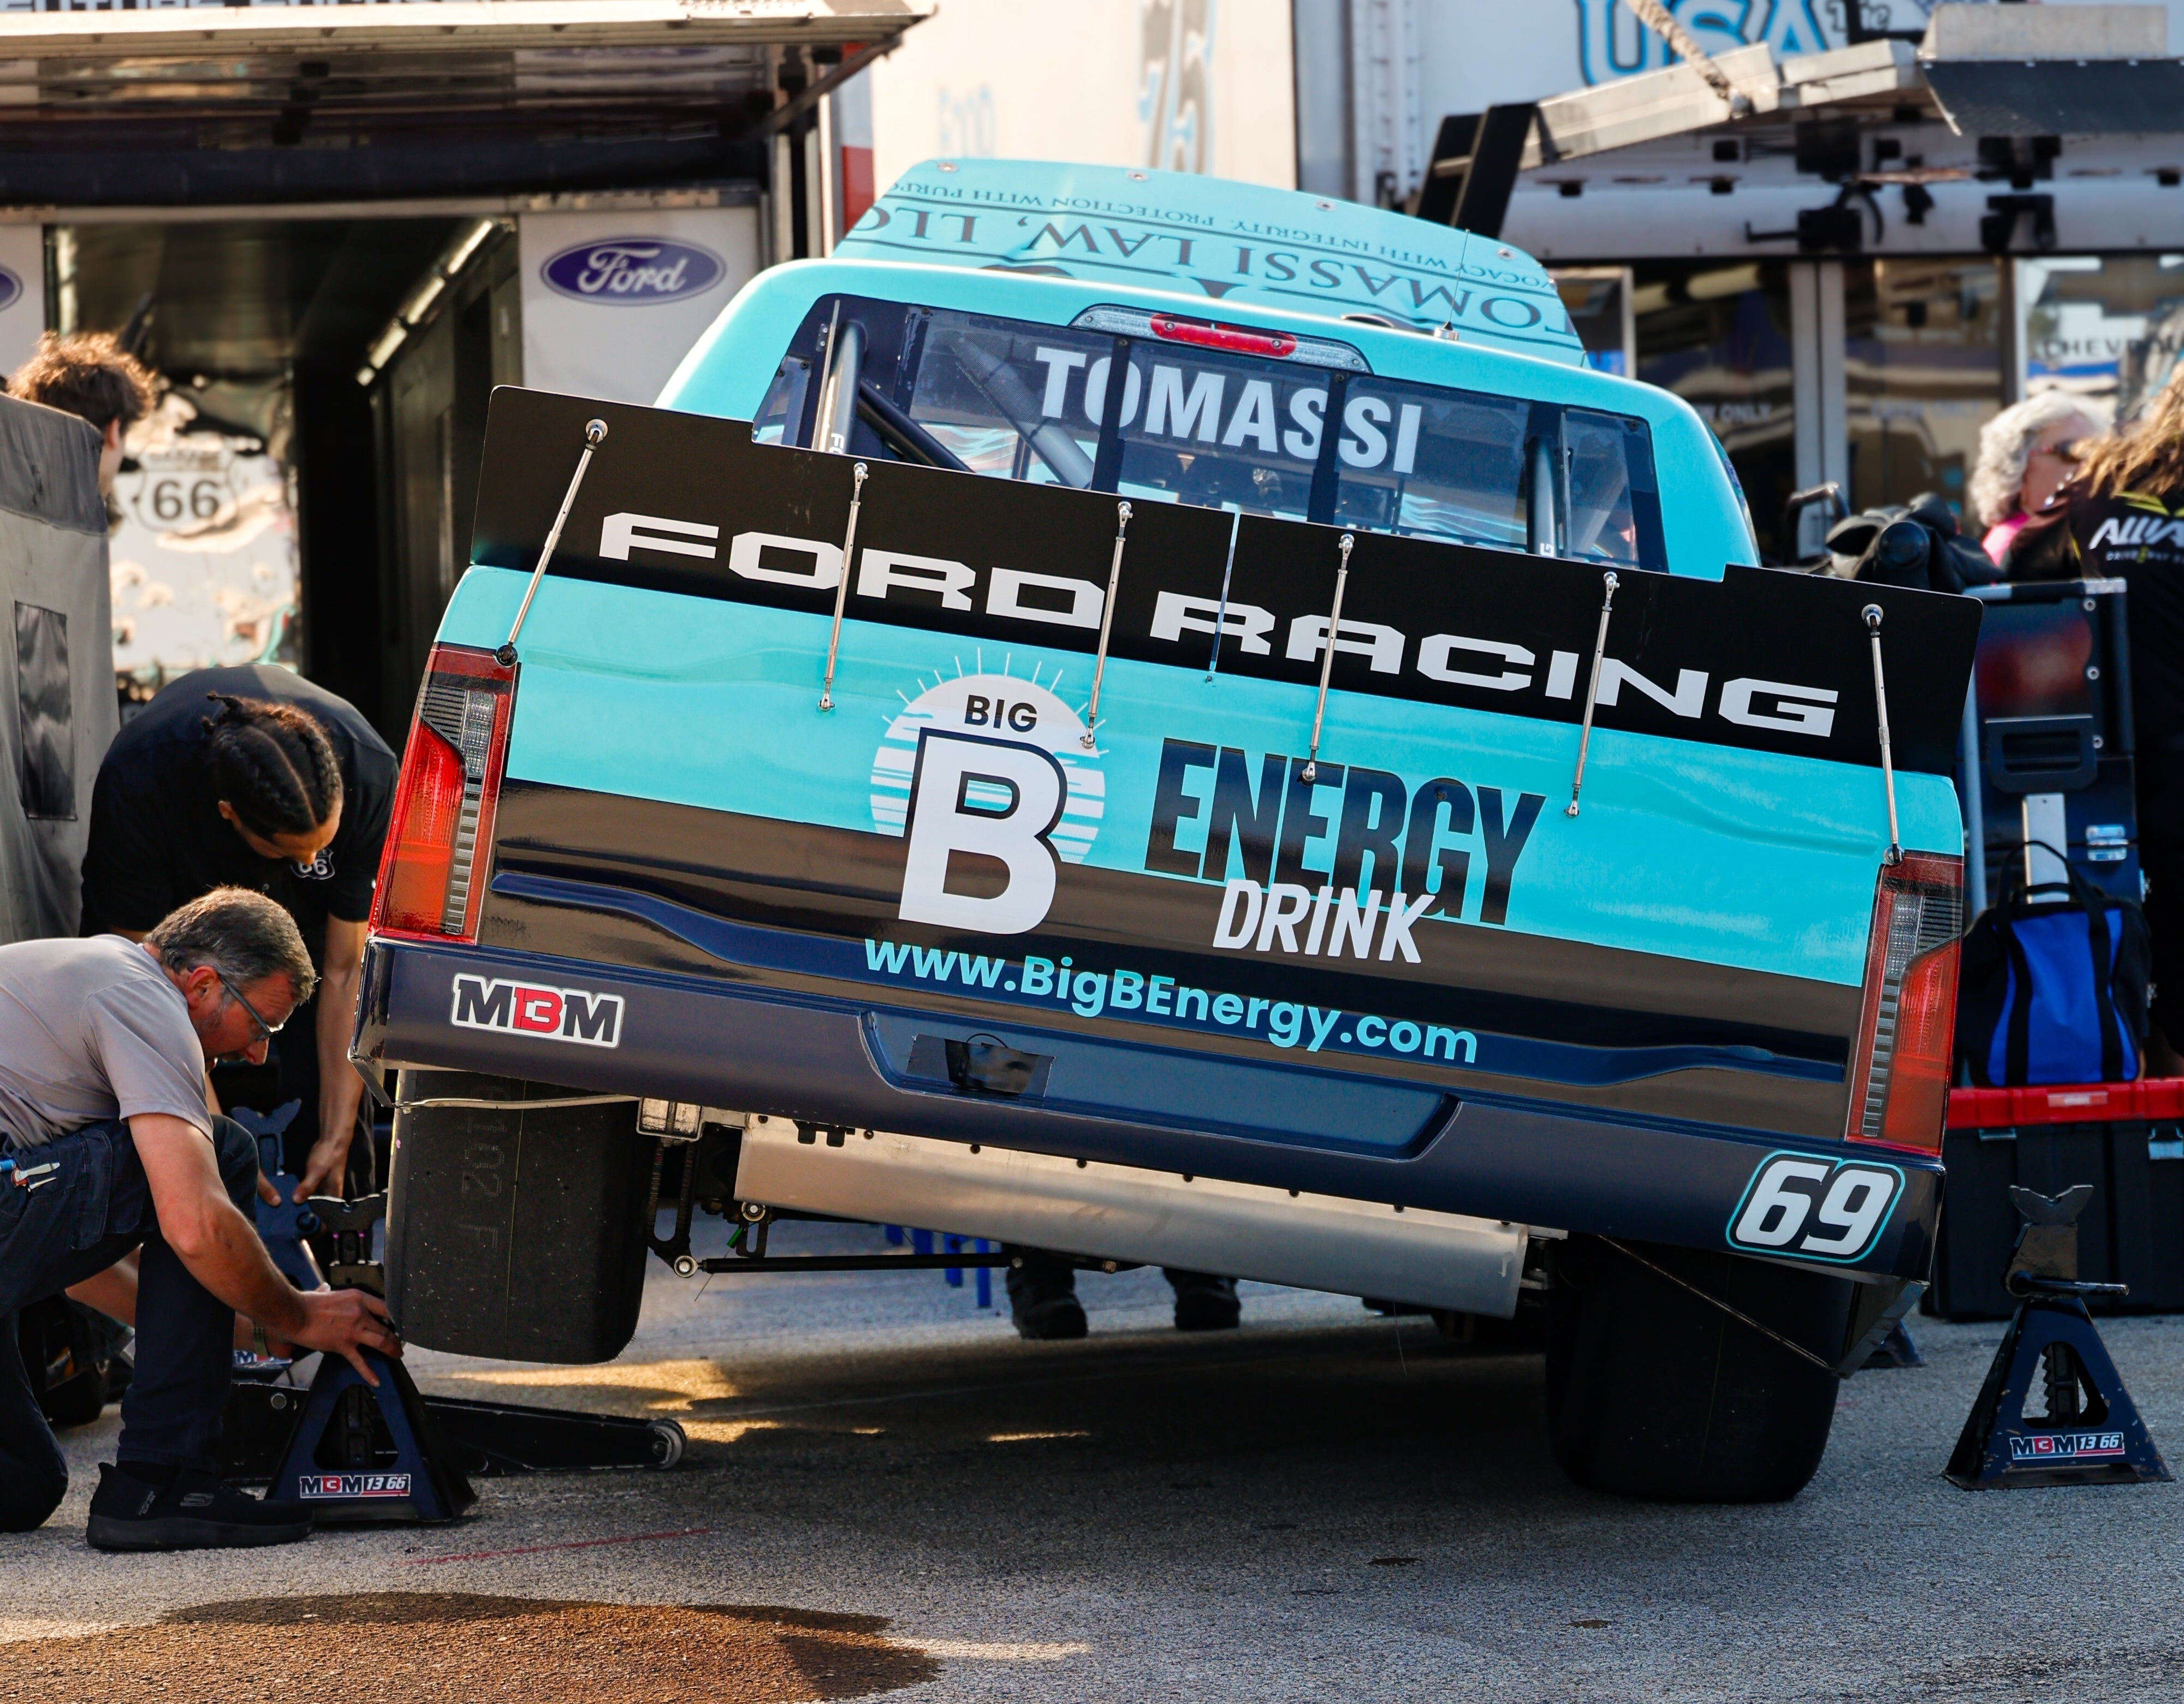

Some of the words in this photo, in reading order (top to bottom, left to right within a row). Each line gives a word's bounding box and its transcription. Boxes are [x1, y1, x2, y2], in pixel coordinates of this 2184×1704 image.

[974, 191, 1041, 206] WITH
[1052, 197, 1214, 227] PROTECTION
[1018, 216, 1197, 268] LAW,
[1231, 219, 1368, 251] INTEGRITY.
[1381, 247, 1446, 269] WITH
[577, 246, 689, 294] Ford
[1036, 347, 1422, 473] TOMASSI
[154, 479, 219, 520] 66
[600, 512, 1104, 629] FORD
[1150, 591, 1838, 736] RACING
[964, 694, 1037, 732] BIG
[899, 727, 1067, 934] B
[1144, 738, 1546, 925] ENERGY
[1213, 879, 1435, 963] DRINK
[865, 939, 1477, 1064] www.BigBEnergy.com
[1736, 1160, 1895, 1255] 69
[2080, 1436, 2097, 1450] 13
[2099, 1435, 2120, 1449] 66
[366, 1477, 384, 1491] 13
[386, 1476, 407, 1490] 66
